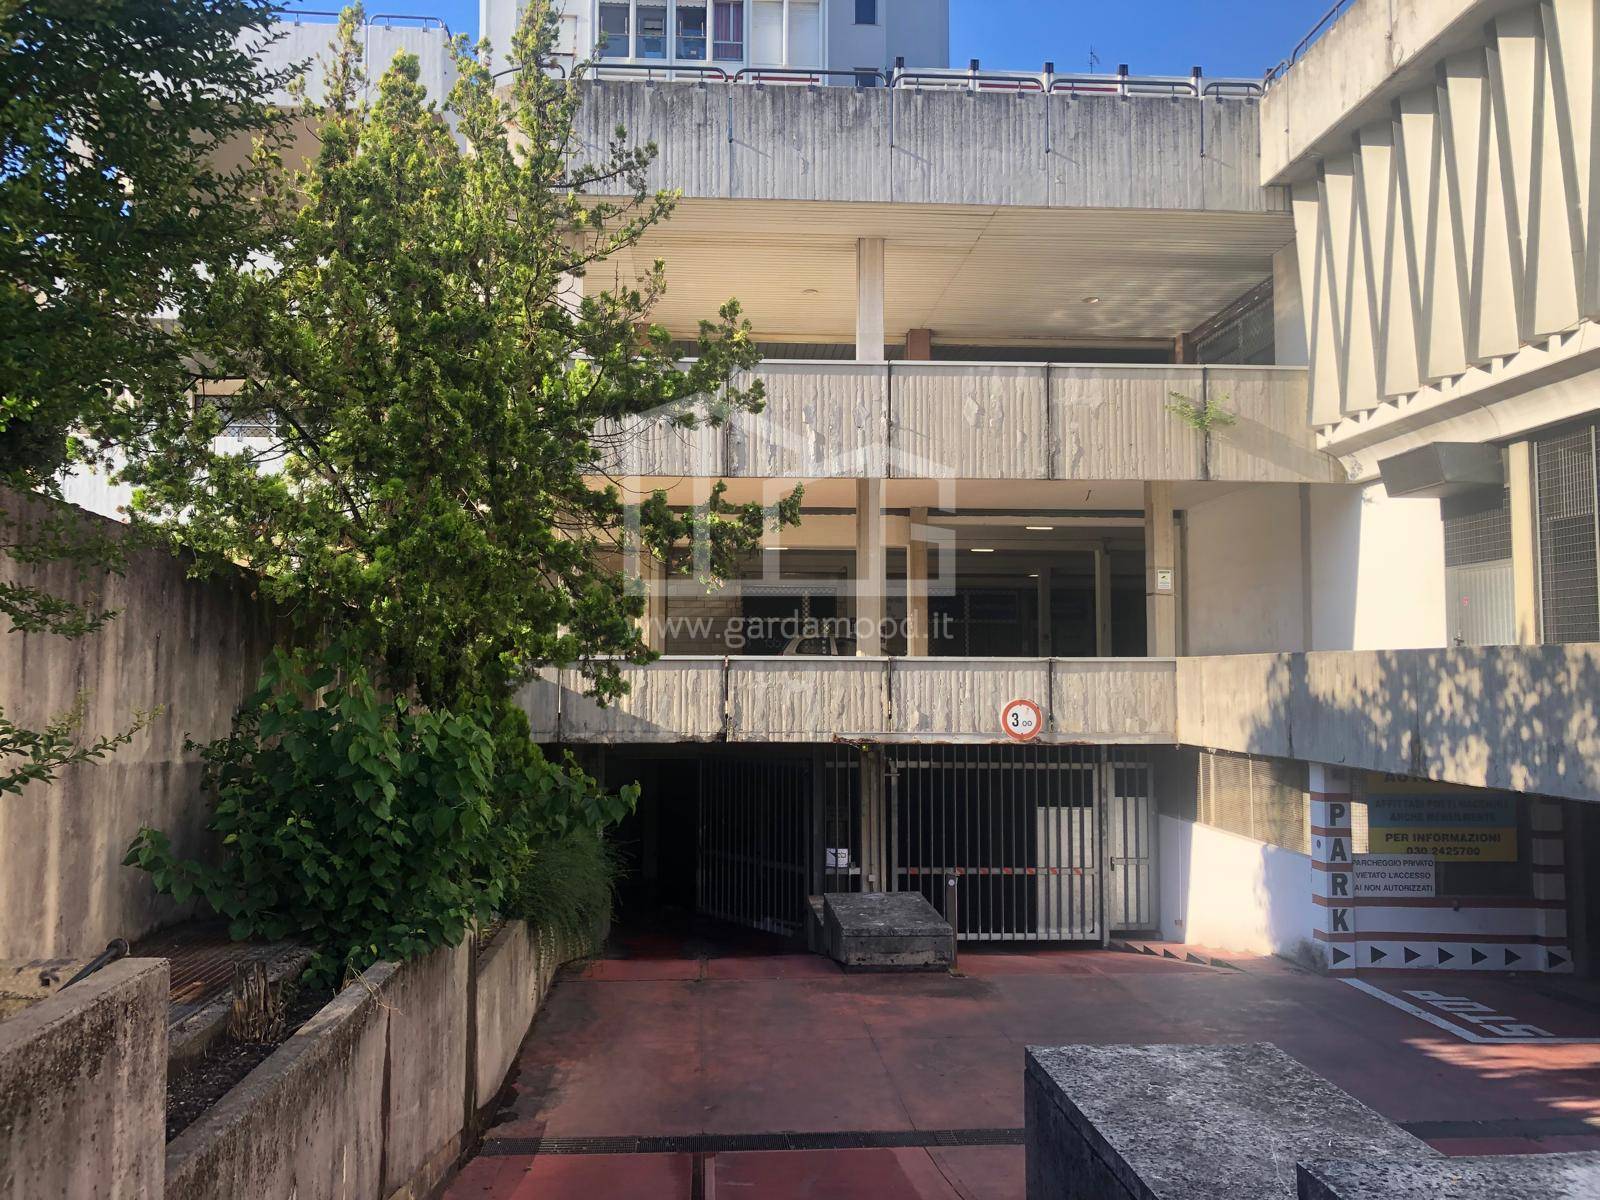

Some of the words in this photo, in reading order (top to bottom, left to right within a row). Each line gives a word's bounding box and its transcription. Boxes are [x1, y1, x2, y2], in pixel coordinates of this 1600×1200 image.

[1385, 833, 1408, 842] PER
[1412, 833, 1501, 842] INFORMAZIONI
[1329, 802, 1349, 932] PARK
[1353, 859, 1401, 867] PARCHEGGIO
[1403, 859, 1434, 867] PRIVATO
[1354, 884, 1361, 892] AI
[1364, 884, 1381, 892] NON
[1383, 884, 1433, 892] AUTORIZZATI
[1402, 990, 1556, 1037] STOP
